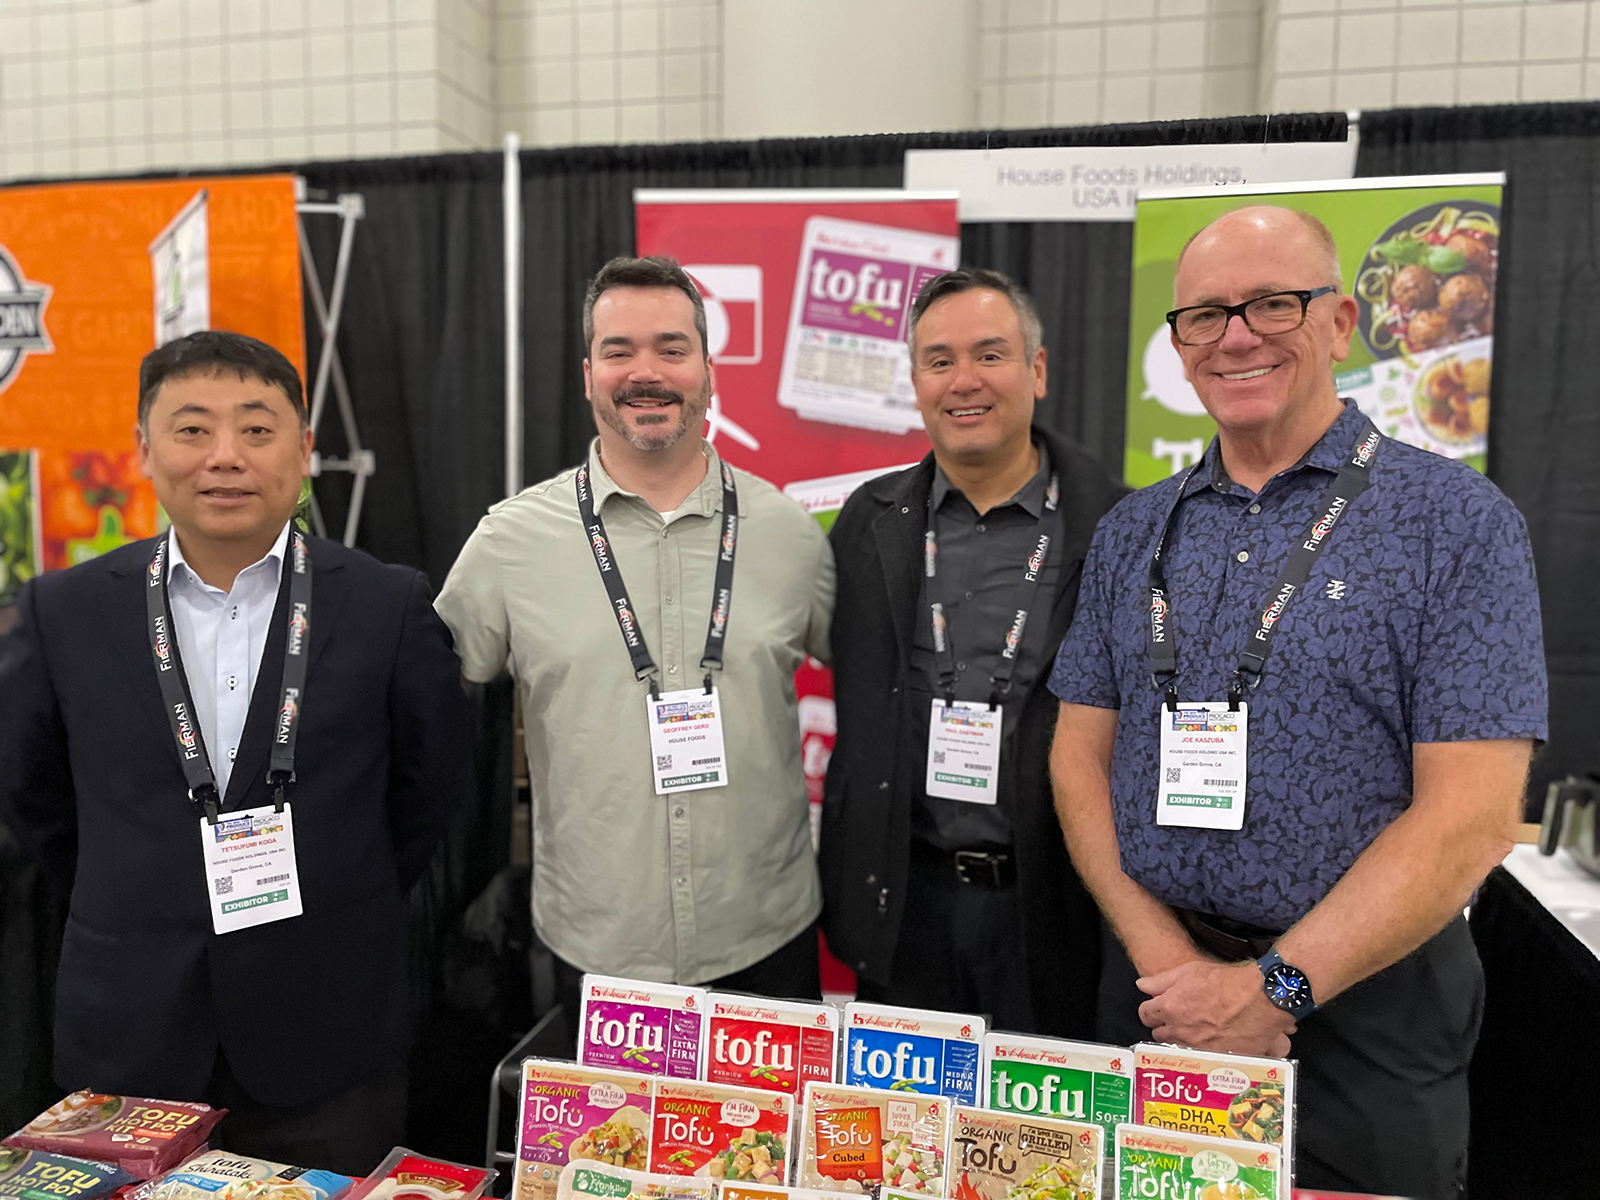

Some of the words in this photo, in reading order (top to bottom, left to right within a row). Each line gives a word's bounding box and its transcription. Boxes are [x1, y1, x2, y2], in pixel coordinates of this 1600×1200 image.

[997, 165, 1065, 186] House
[1071, 165, 1138, 185] Foods
[1072, 188, 1121, 209] USA
[811, 257, 903, 310] tofu
[1352, 431, 1379, 468] FIERMAN
[1303, 497, 1347, 552] FIERMAN
[589, 524, 611, 572] FIERMAN
[150, 540, 166, 587] FIERMAN
[1025, 535, 1049, 582] FIERMAN
[1150, 587, 1165, 643] FIERMAN
[1255, 583, 1294, 641] FIERMAN
[288, 602, 306, 656] FIERMAN
[615, 598, 639, 647] FIERMAN
[1002, 609, 1028, 659] FIERMAN
[155, 616, 171, 671] FIERMAN
[279, 687, 299, 744] FIERMAN
[174, 703, 199, 760] FIERMAN
[663, 726, 692, 734] GEOFFREY
[664, 776, 702, 787] EXHIBITOR
[937, 774, 972, 785] EXHIBITOR
[1169, 796, 1212, 806] EXHIBITOR
[221, 842, 258, 853] TETSUFUMI
[258, 838, 277, 846] KODA
[231, 866, 248, 874] Garden
[224, 895, 268, 912] EXHIBITOR
[602, 988, 627, 999] House
[628, 990, 651, 1002] Foods
[726, 1005, 753, 1017] House
[754, 1007, 779, 1020] Foods
[589, 1010, 664, 1052] tofu
[865, 1015, 893, 1028] House
[895, 1018, 921, 1031] Foods
[673, 1040, 697, 1050] EXTRA
[714, 1028, 794, 1071] tofu
[671, 1048, 696, 1061] FIRM
[852, 1039, 936, 1085] tofu
[1008, 1048, 1038, 1060] House
[1040, 1051, 1067, 1064] Foods
[803, 1064, 829, 1077] FIRM
[1152, 1057, 1177, 1067] House
[1178, 1059, 1201, 1070] Foods
[534, 1085, 581, 1100] ORGANIC
[945, 1078, 973, 1092] FIRM
[590, 1089, 608, 1098] EXTRA
[609, 1090, 624, 1100] FIRM
[996, 1070, 1086, 1118] tofu
[663, 1102, 712, 1118] ORGANIC
[740, 1102, 755, 1113] FIRM
[128, 1106, 200, 1126] TOFU
[826, 1110, 870, 1122] ORGANIC
[891, 1112, 912, 1121] SUPER
[893, 1119, 909, 1128] FIRM
[1095, 1111, 1127, 1124] SOFT
[1180, 1108, 1215, 1125] DHA
[104, 1124, 135, 1133] KIT
[113, 1117, 152, 1128] HOT
[149, 1122, 187, 1132] POT
[1148, 1116, 1227, 1138] Omega-3
[961, 1126, 1014, 1145] ORGANIC
[1021, 1133, 1070, 1151] GRILLED
[212, 1157, 252, 1169] tofu
[832, 1152, 865, 1163] Cubed
[26, 1161, 101, 1189] TOFU
[184, 1163, 255, 1180] Shirataki
[0, 1183, 27, 1196] KIT
[8, 1174, 48, 1188] HOT
[42, 1181, 82, 1197] POT
[592, 1177, 626, 1193] Franklin
